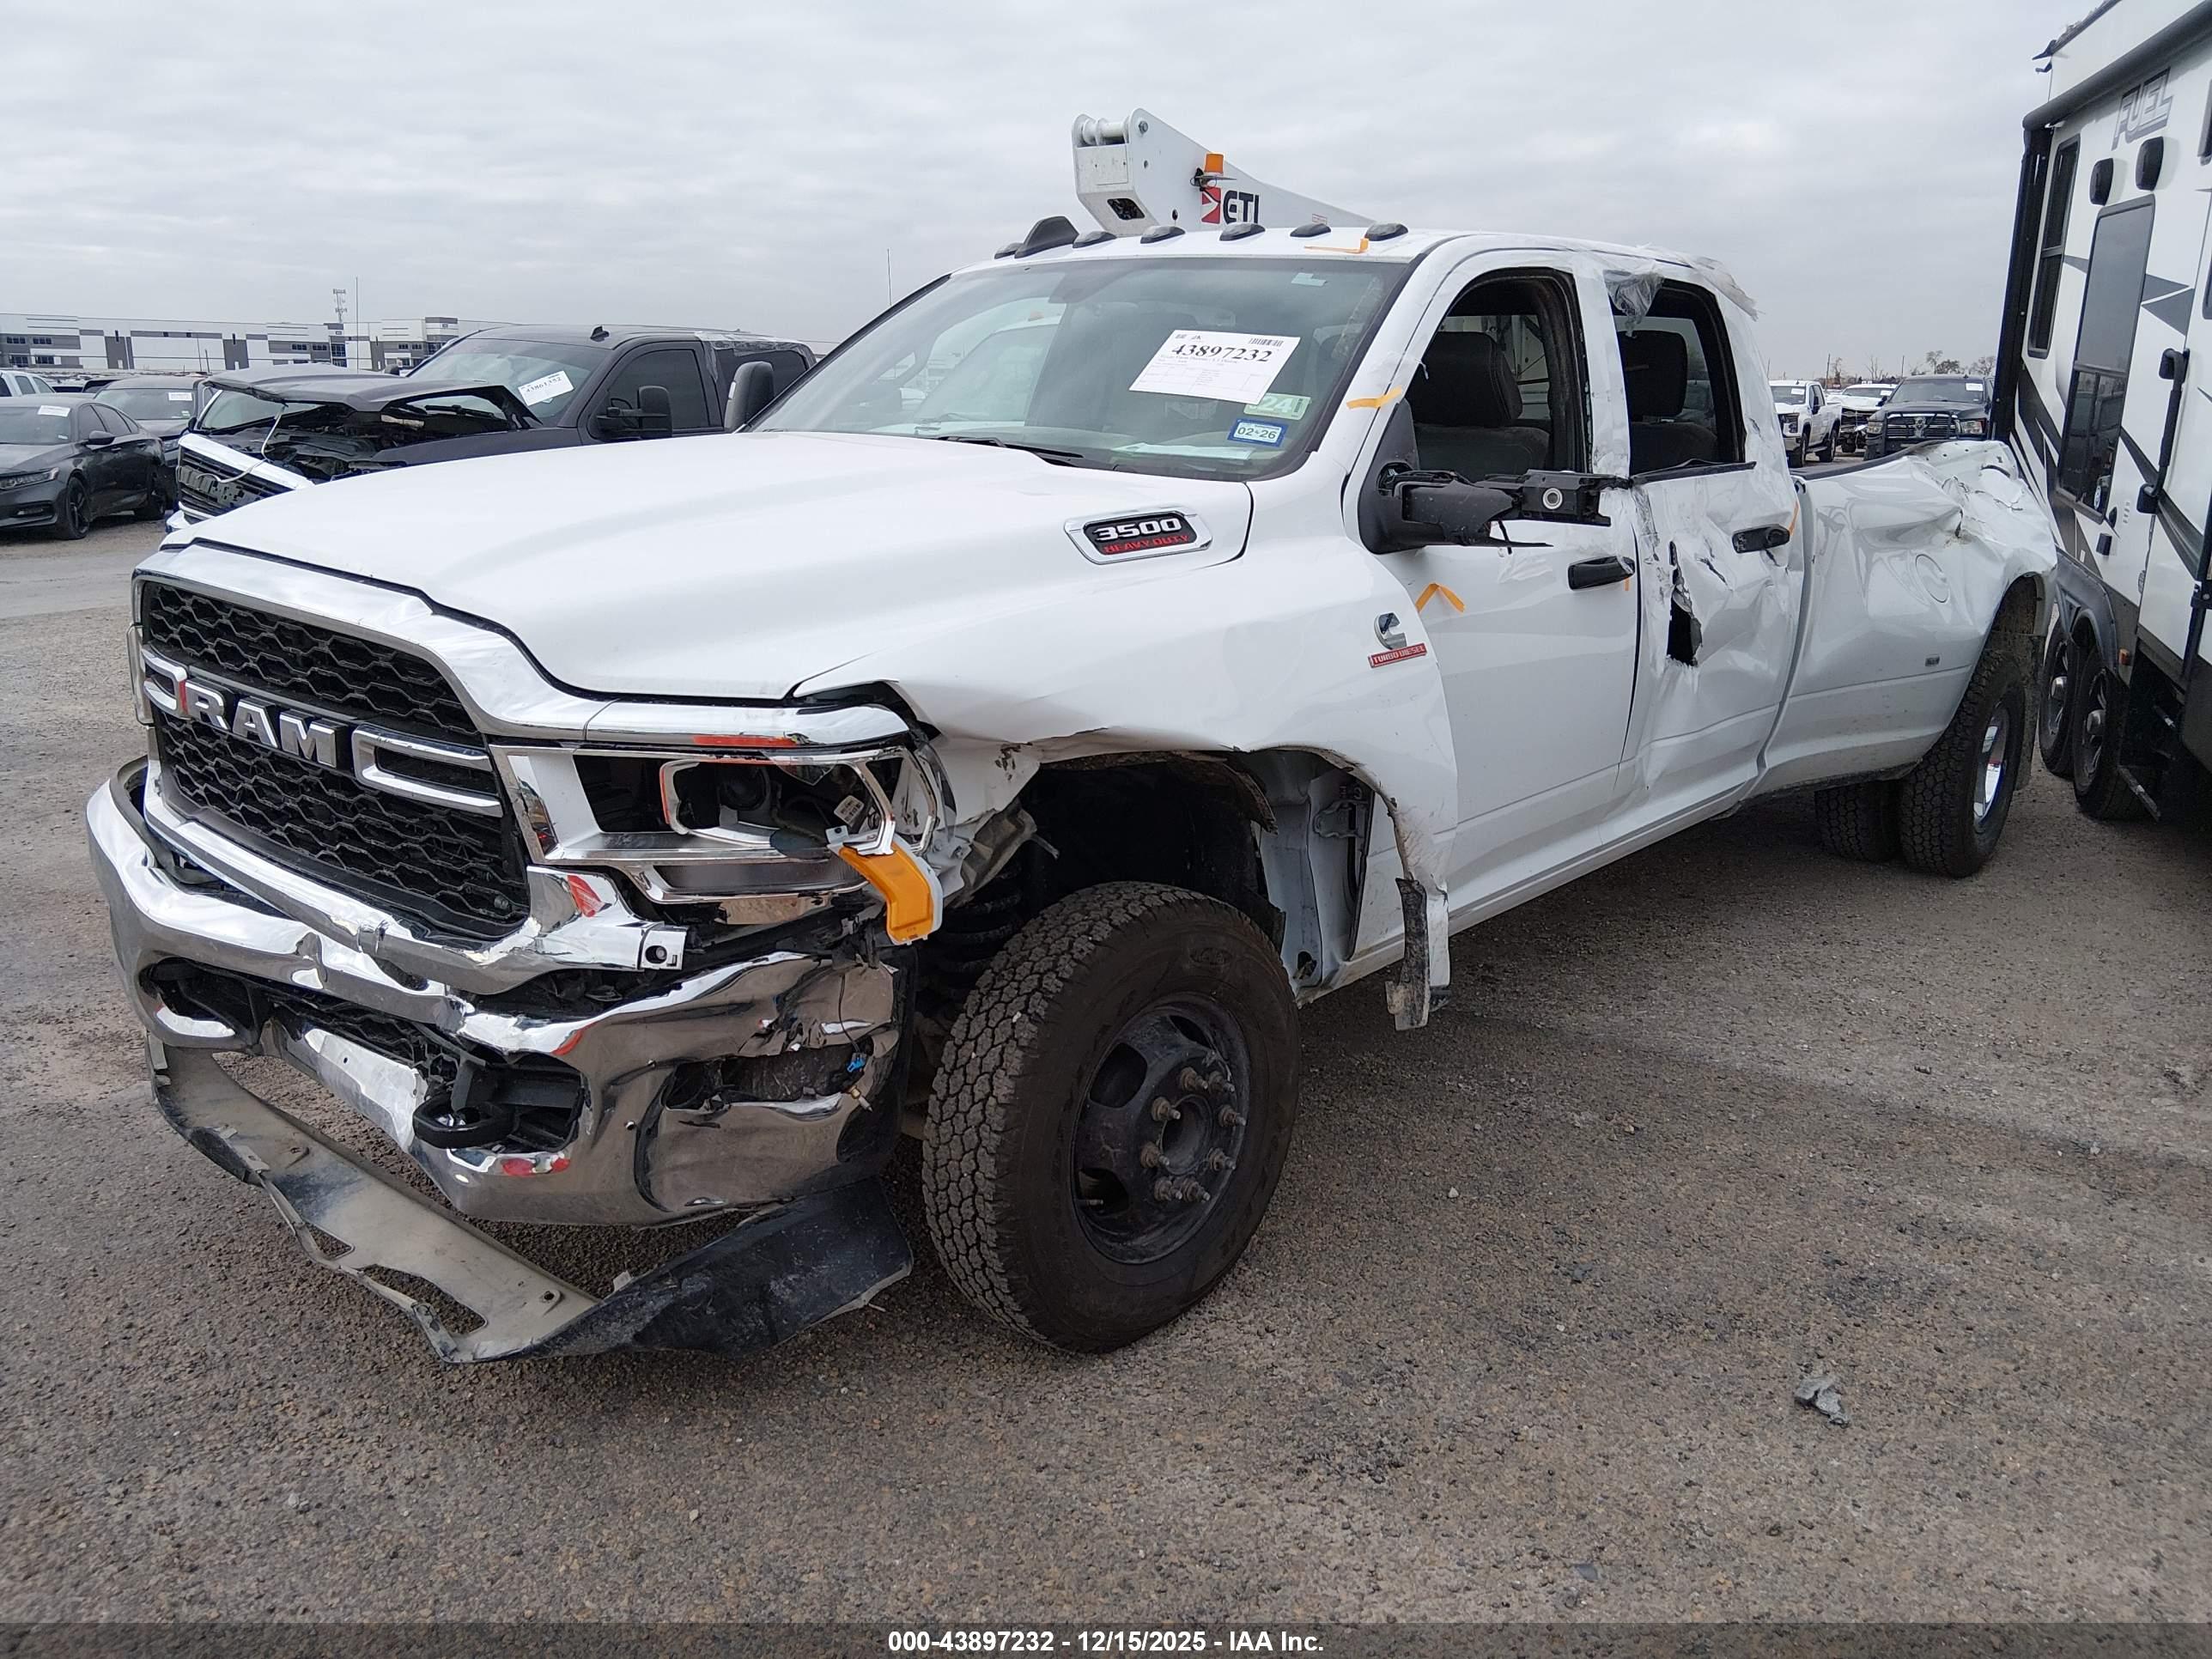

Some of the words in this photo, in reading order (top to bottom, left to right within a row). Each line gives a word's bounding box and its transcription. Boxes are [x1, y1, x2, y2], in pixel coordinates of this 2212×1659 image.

[2112, 68, 2172, 149] FUEL
[1223, 189, 1260, 224] ETI
[1171, 343, 1273, 362] 43897232
[1093, 518, 1182, 541] 3500
[1104, 539, 1150, 553] HEAVY
[1152, 534, 1189, 546] DUTY
[1373, 651, 1400, 664] TURBO
[1400, 645, 1425, 658] DIESEL
[185, 681, 337, 769] RAM
